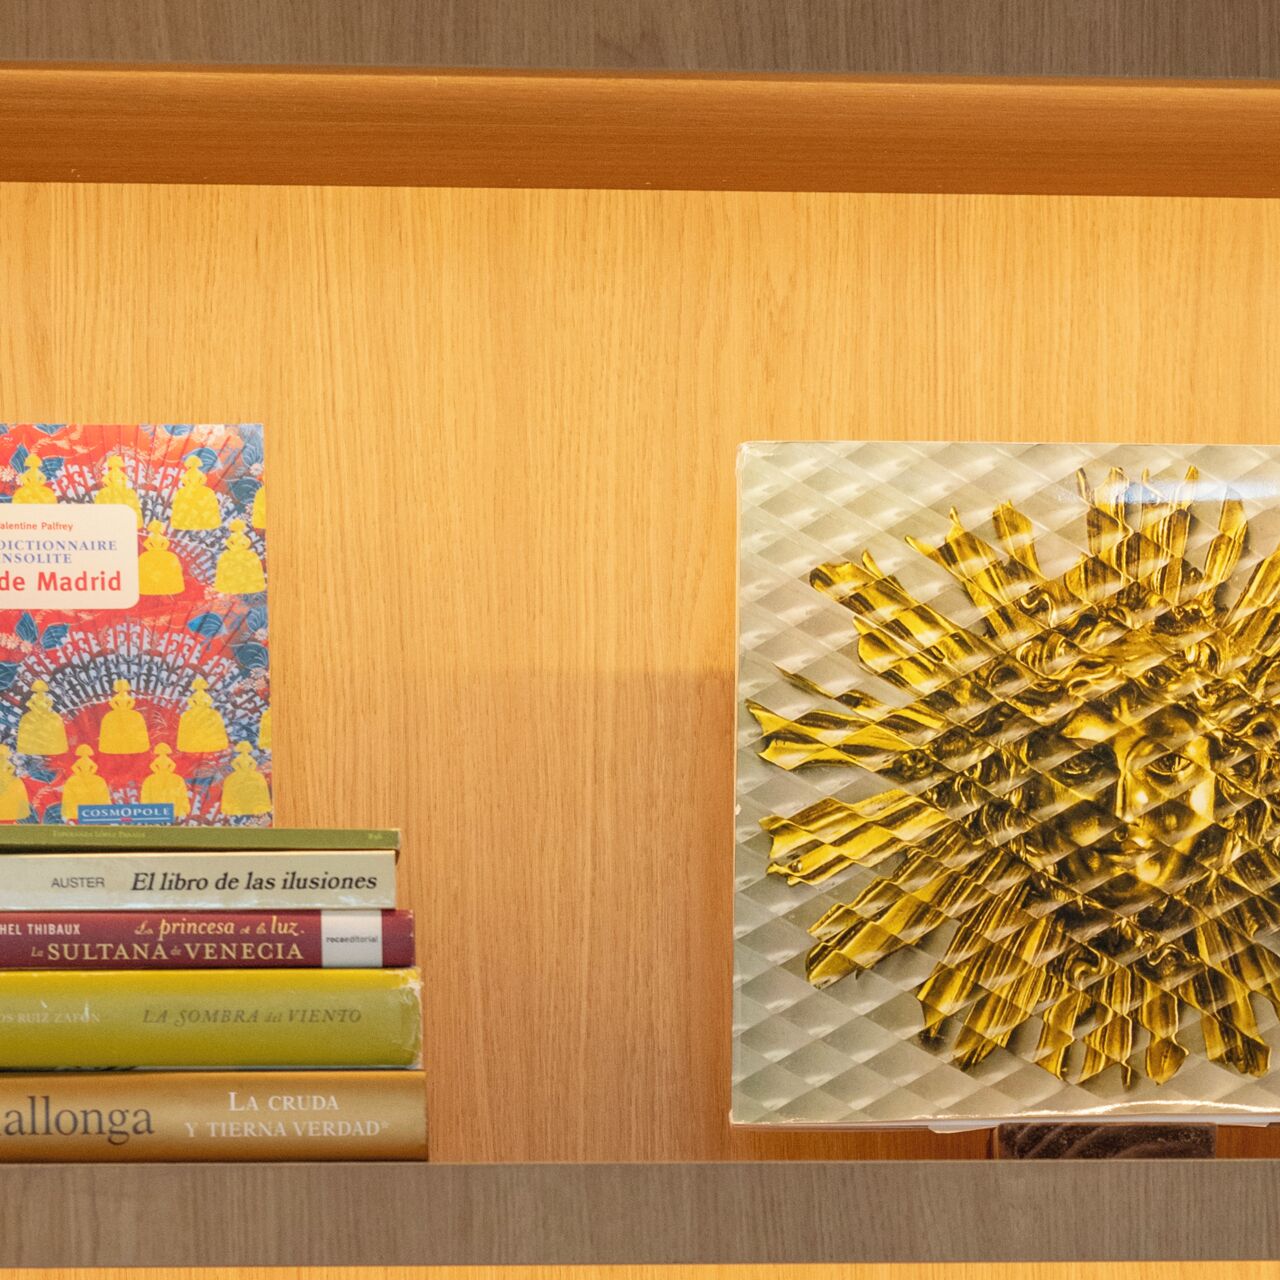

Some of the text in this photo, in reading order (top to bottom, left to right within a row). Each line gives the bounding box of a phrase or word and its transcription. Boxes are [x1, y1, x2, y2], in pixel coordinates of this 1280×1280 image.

[41, 521, 74, 532] Palfrey
[0, 553, 73, 564] NSOLITE
[0, 570, 121, 592] de Madrid
[81, 806, 170, 818] COSMOPOLE
[51, 870, 378, 891] AUSTER El libro de las ilusiones
[27, 923, 81, 936] THIBAUX
[157, 917, 235, 942] princesa
[326, 935, 378, 944] rocaeditorial
[47, 943, 170, 961] SULTANA
[183, 943, 305, 961] VENECIA
[142, 1008, 363, 1027] LA SOMBRA VIENTO
[228, 1091, 341, 1112] LA CRUDA
[0, 1095, 155, 1146] allonga
[184, 1121, 287, 1139] Y TIERNA
